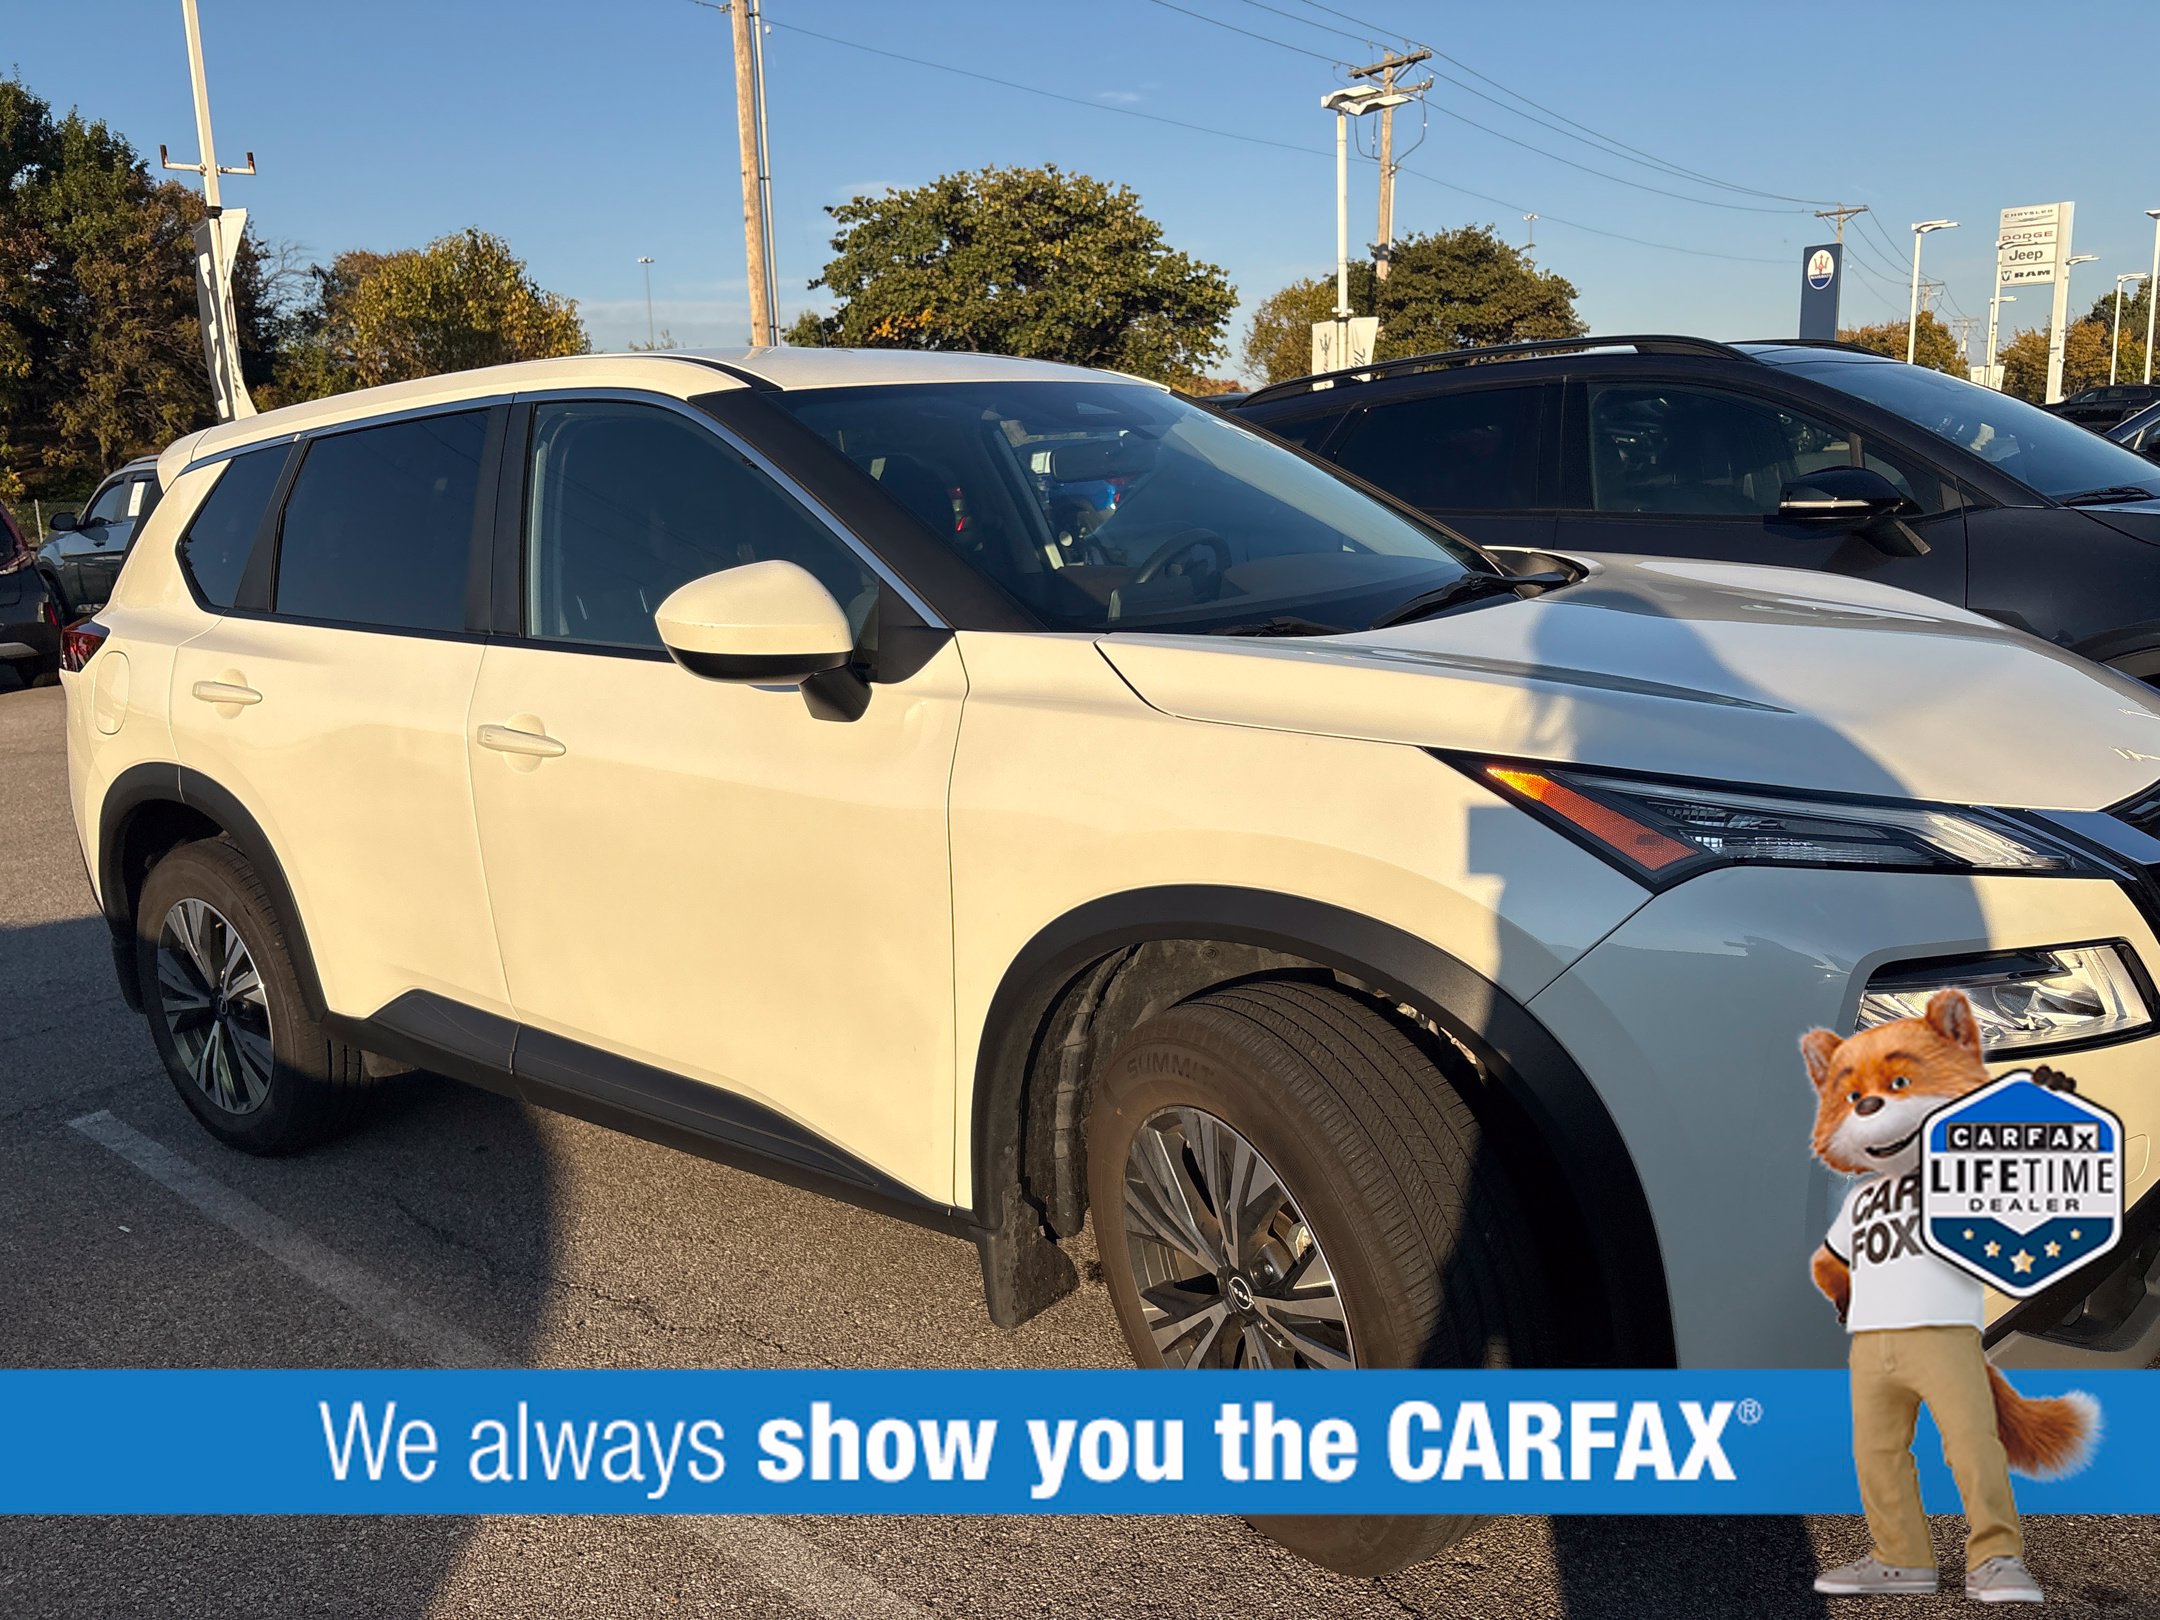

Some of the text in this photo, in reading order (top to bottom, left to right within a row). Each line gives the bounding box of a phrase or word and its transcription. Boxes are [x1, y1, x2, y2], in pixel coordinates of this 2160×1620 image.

[2004, 209, 2053, 218] CHRYSLER
[2002, 231, 2053, 241] DODGE
[2009, 250, 2043, 261] Jeep
[2015, 270, 2050, 278] RAM
[1127, 1052, 1215, 1087] SUMMIT
